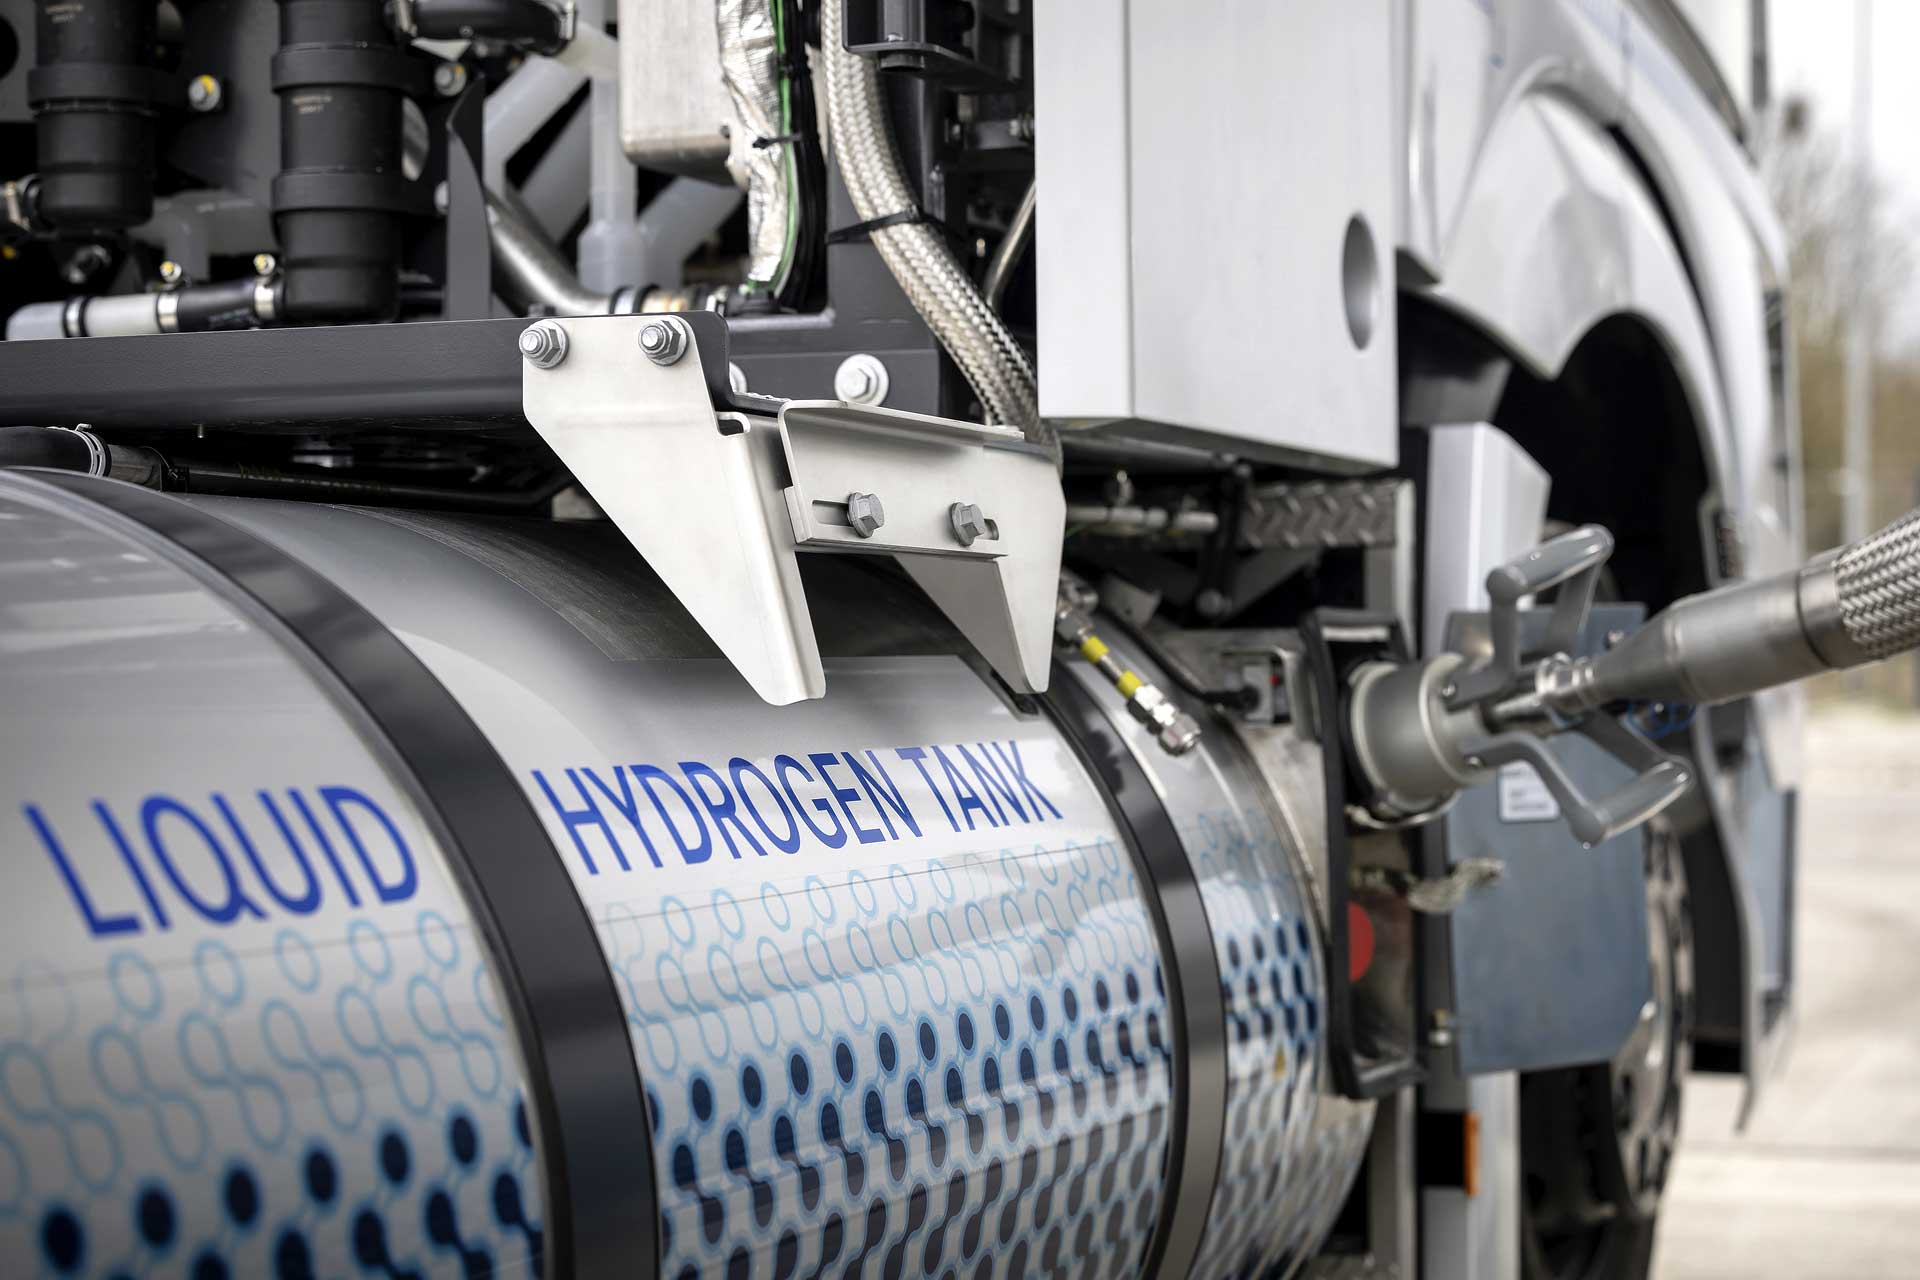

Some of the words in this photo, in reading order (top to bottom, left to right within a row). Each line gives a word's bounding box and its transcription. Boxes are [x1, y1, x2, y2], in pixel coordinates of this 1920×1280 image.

[23, 785, 418, 937] LIQUID
[532, 750, 922, 876] HYDROGEN
[895, 740, 1063, 833] TANK
